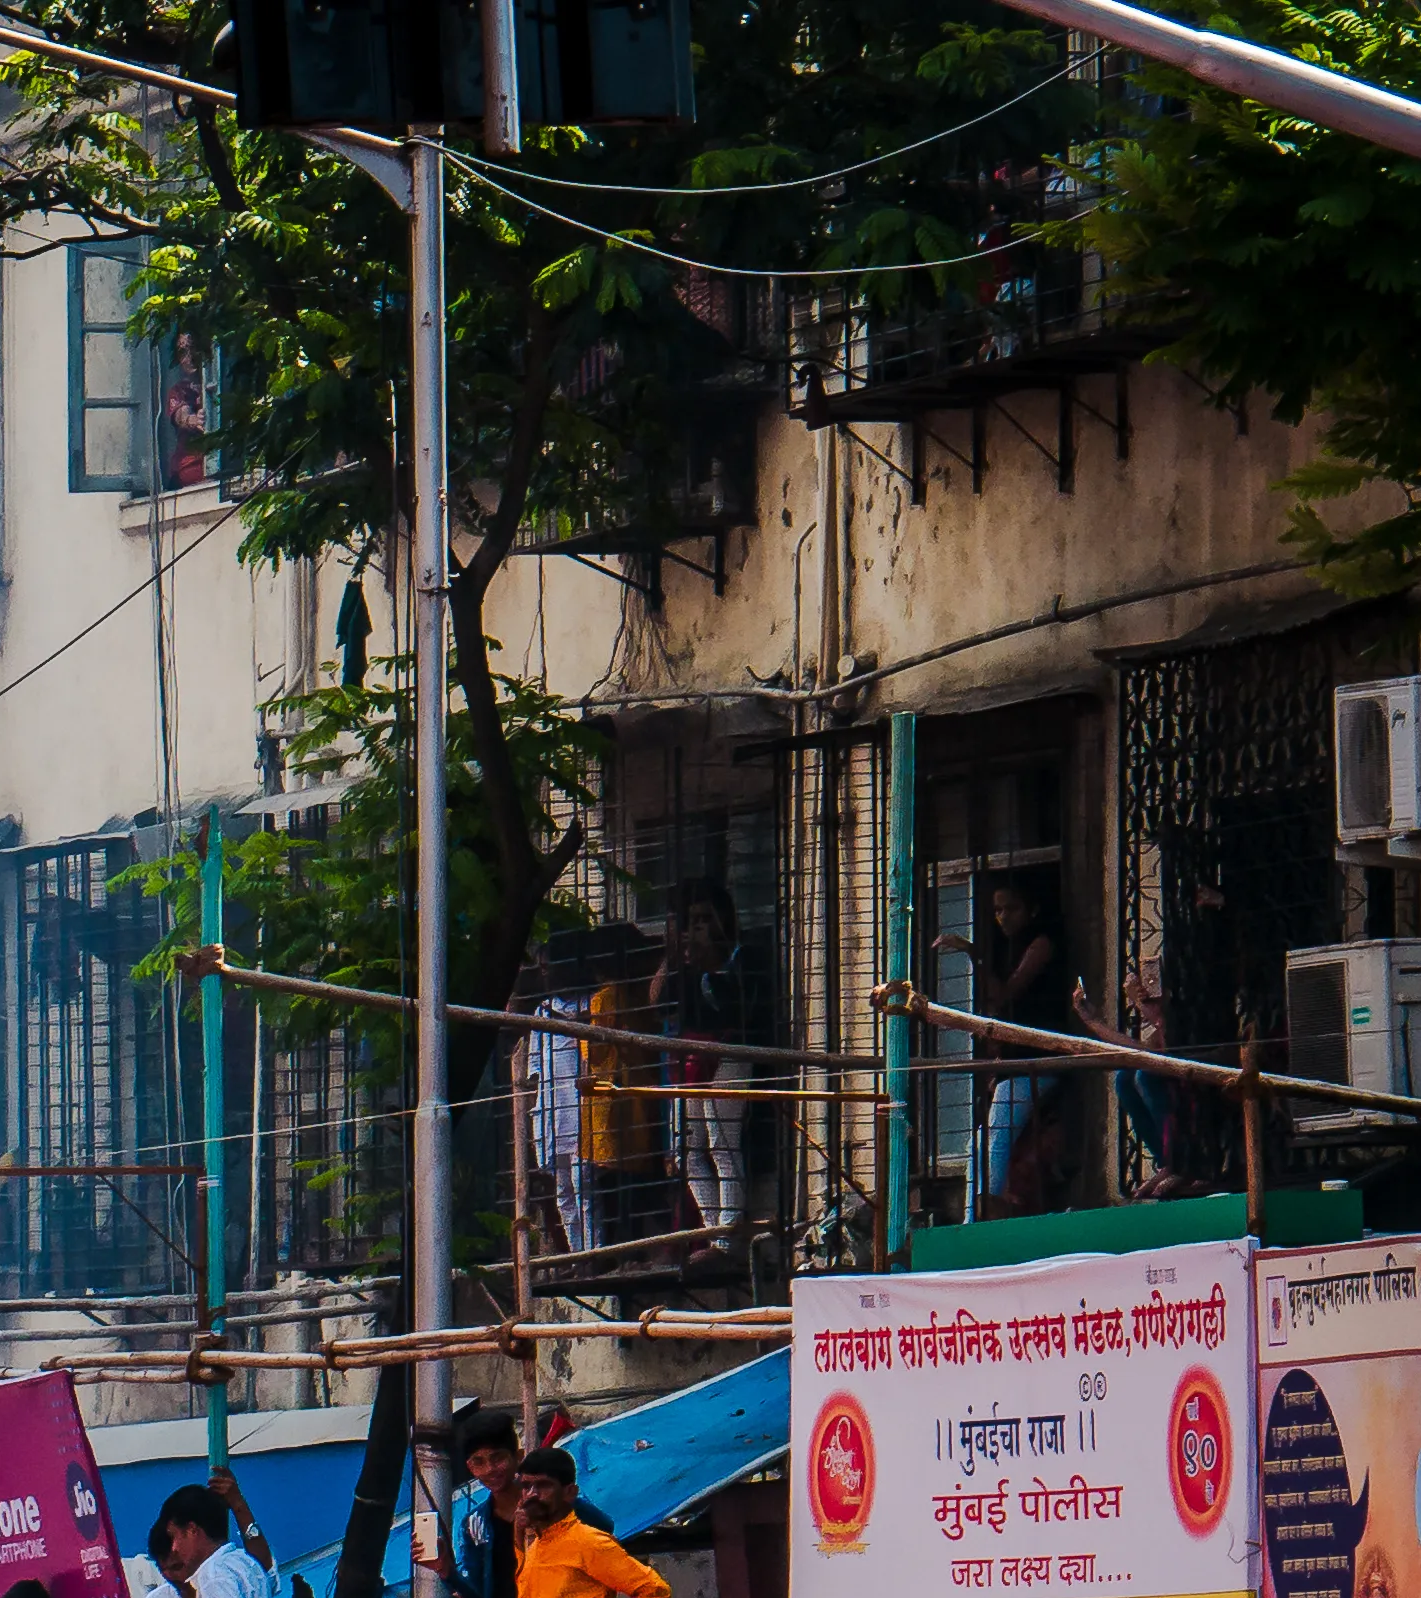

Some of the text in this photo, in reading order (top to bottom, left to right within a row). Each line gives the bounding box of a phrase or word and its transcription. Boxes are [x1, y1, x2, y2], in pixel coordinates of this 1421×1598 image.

[814, 1325, 892, 1373] लालबाग
[898, 1308, 1003, 1369] सार्वजनिक
[1006, 1311, 1067, 1363] उत्सव
[959, 1401, 1022, 1477] मुंबईचा
[1027, 1413, 1066, 1455] राजा
[73, 1480, 98, 1518] Jio
[931, 1477, 1011, 1542] मुंबई
[1019, 1473, 1125, 1525] पोलीस
[951, 1557, 995, 1589] जरा
[999, 1555, 1054, 1587] लक्ष्य
